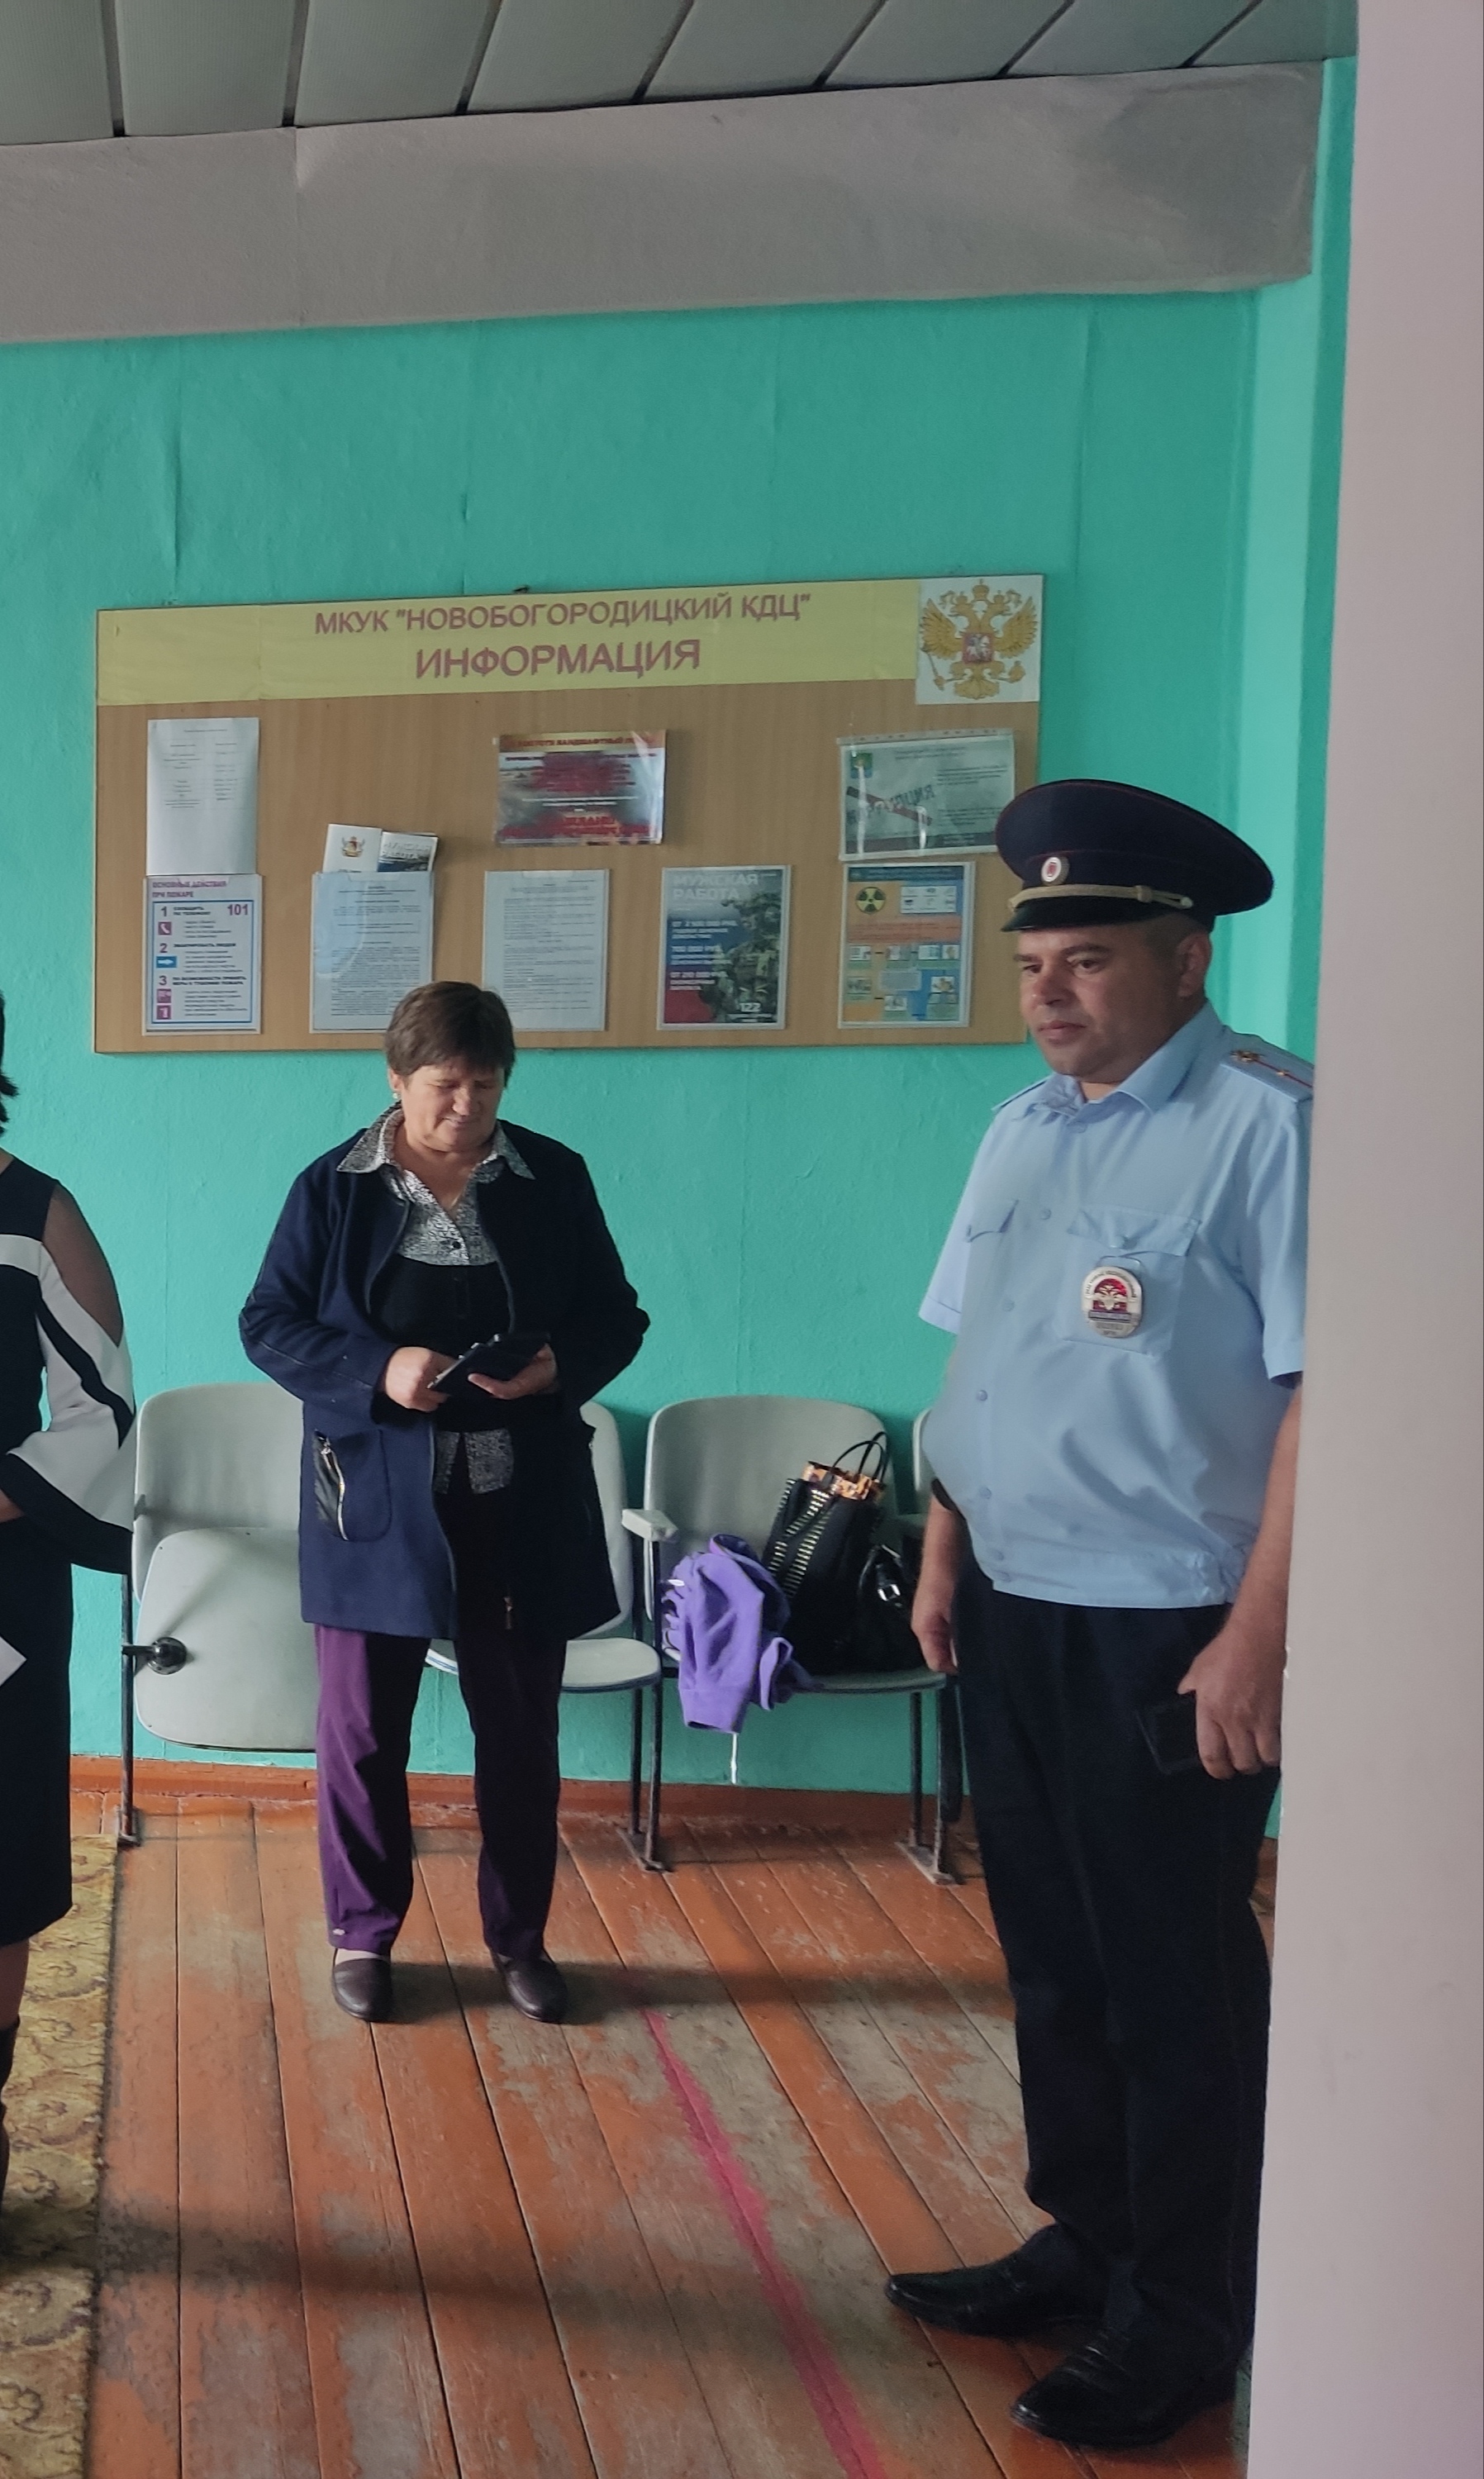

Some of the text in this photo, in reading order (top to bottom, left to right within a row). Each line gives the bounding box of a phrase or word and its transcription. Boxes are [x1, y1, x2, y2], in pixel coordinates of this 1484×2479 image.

[315, 592, 811, 634] МКУК "НОВОБОГОРОДИЦКИЙ КДЦ"
[416, 639, 701, 679] ИНФОРМАЦИЯ
[673, 888, 740, 899] РАБОТА
[160, 906, 168, 917] 1
[227, 903, 249, 916] 101
[159, 943, 169, 954] 2
[159, 975, 168, 986] 3
[739, 1002, 762, 1012] 122
